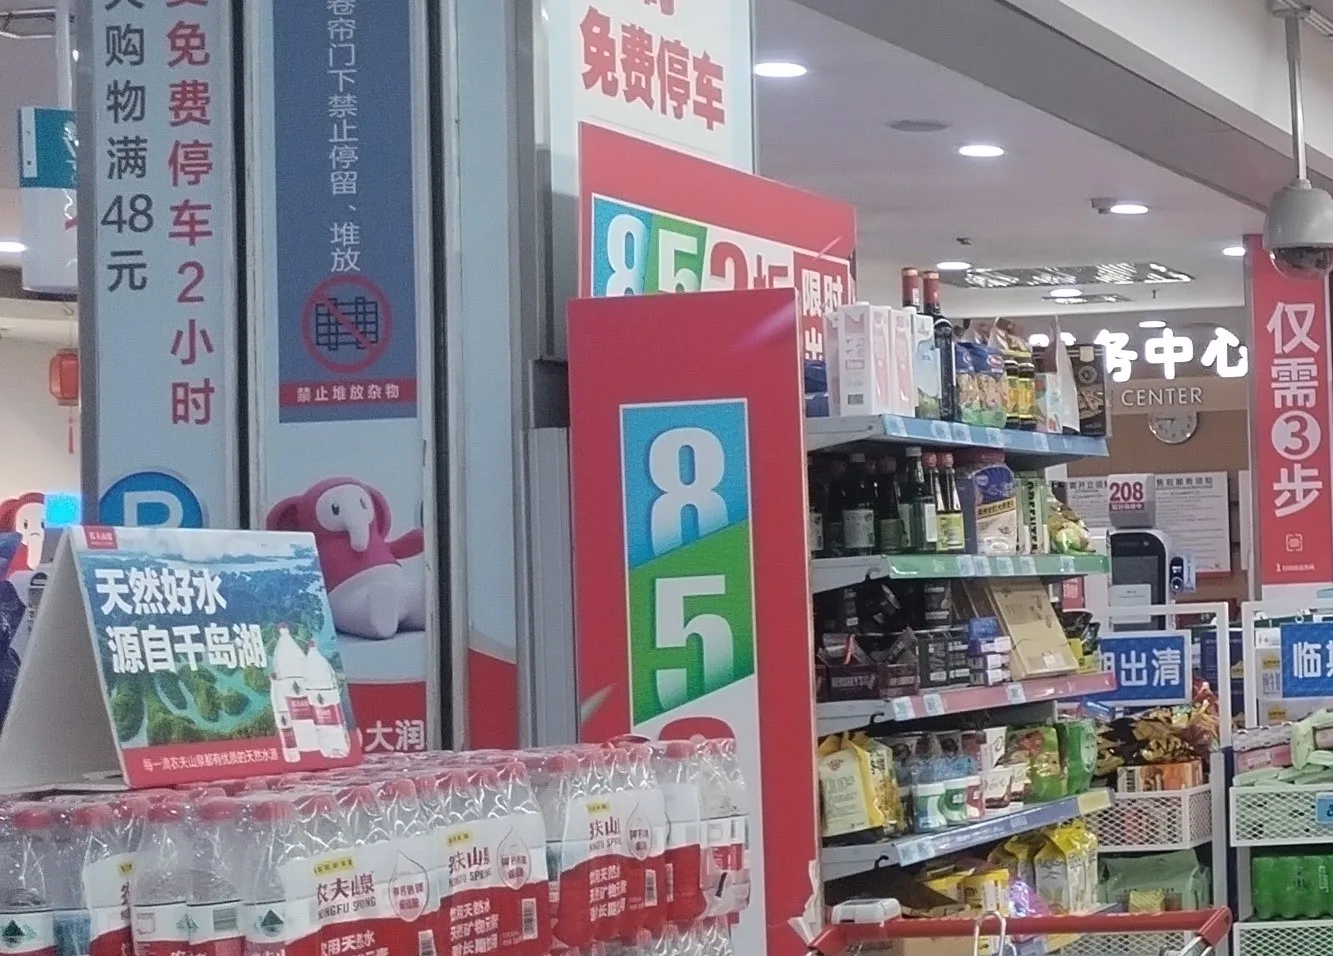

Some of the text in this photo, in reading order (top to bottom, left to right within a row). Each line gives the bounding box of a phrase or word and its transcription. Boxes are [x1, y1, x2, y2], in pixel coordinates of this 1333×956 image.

[580, 6, 726, 131] 免费停车
[296, 383, 400, 404] 禁止堆放杂物
[1121, 387, 1203, 407] CENTER
[1268, 302, 1324, 518] 仅需3步
[1108, 481, 1144, 502] 208
[96, 568, 227, 616] 天然好水
[107, 623, 268, 676] 源自千岛湖
